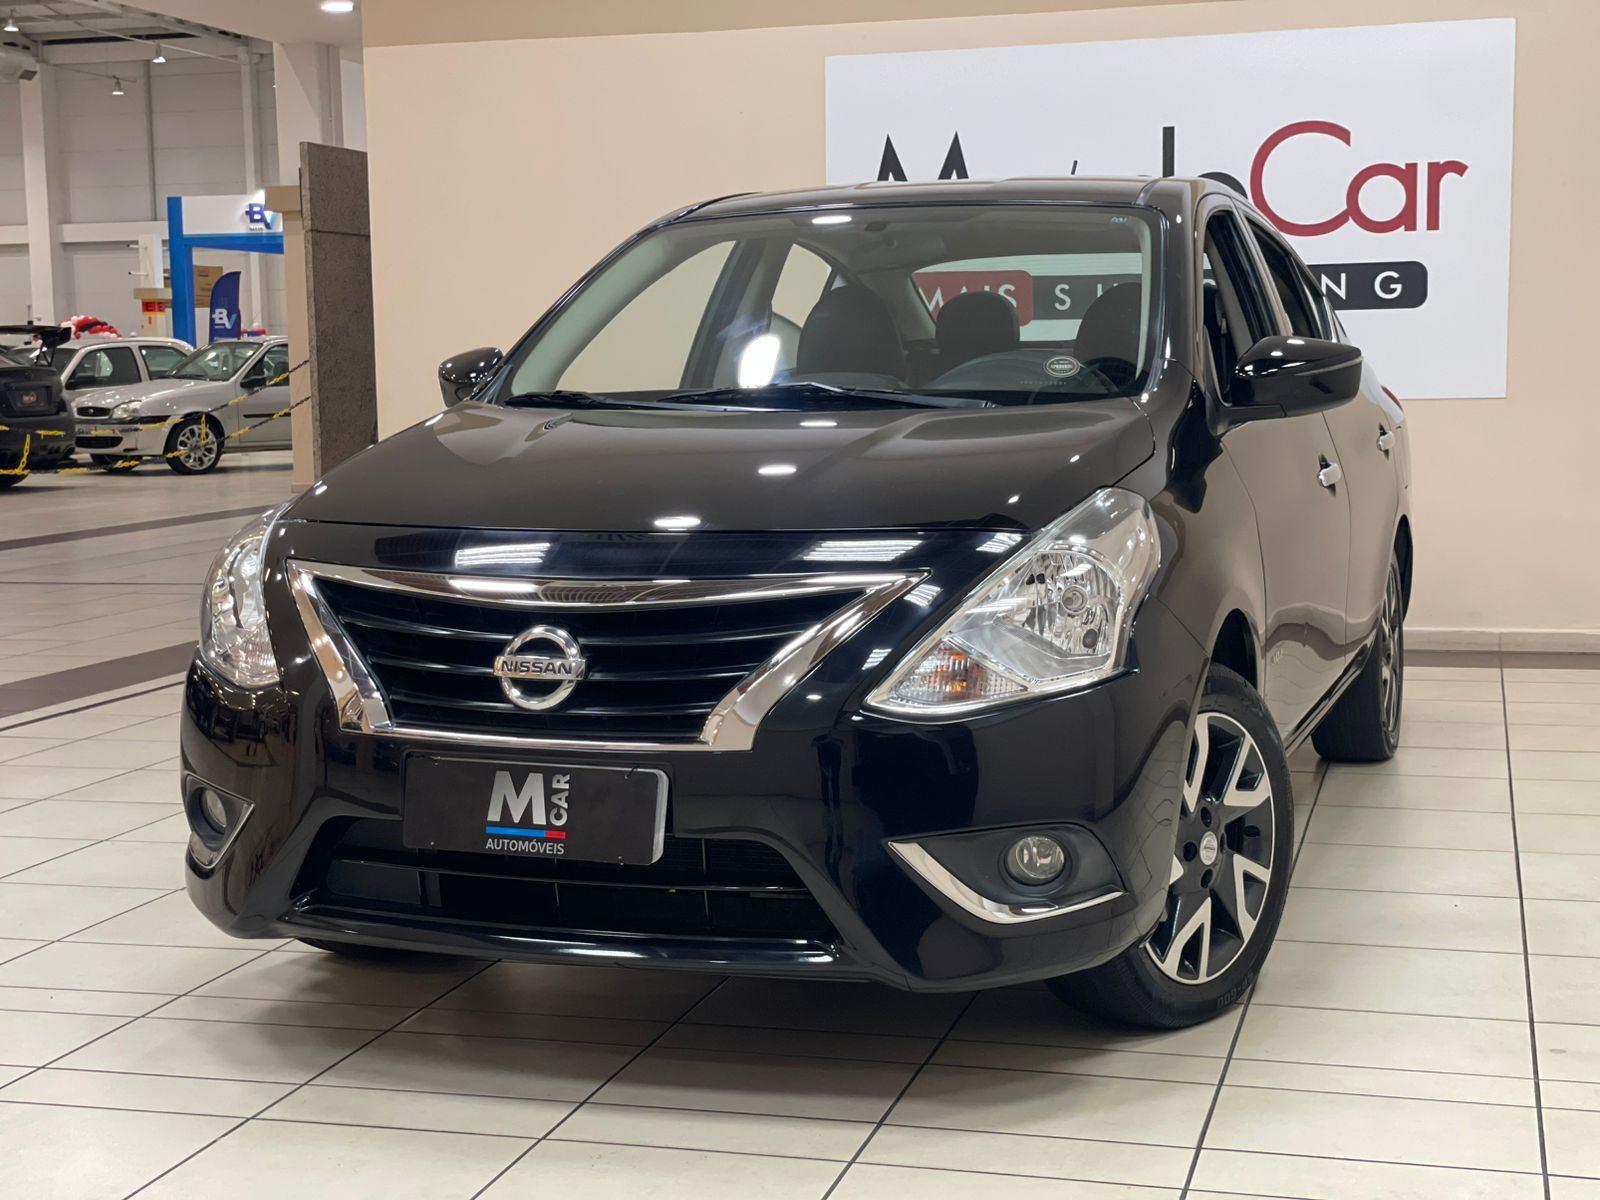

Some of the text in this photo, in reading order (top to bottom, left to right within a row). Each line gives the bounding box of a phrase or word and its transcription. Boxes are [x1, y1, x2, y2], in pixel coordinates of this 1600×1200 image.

[212, 308, 237, 329] BV
[500, 659, 573, 675] NISSAN
[486, 770, 571, 827] M CAR
[485, 838, 565, 855] AUTOMÓVEIS
